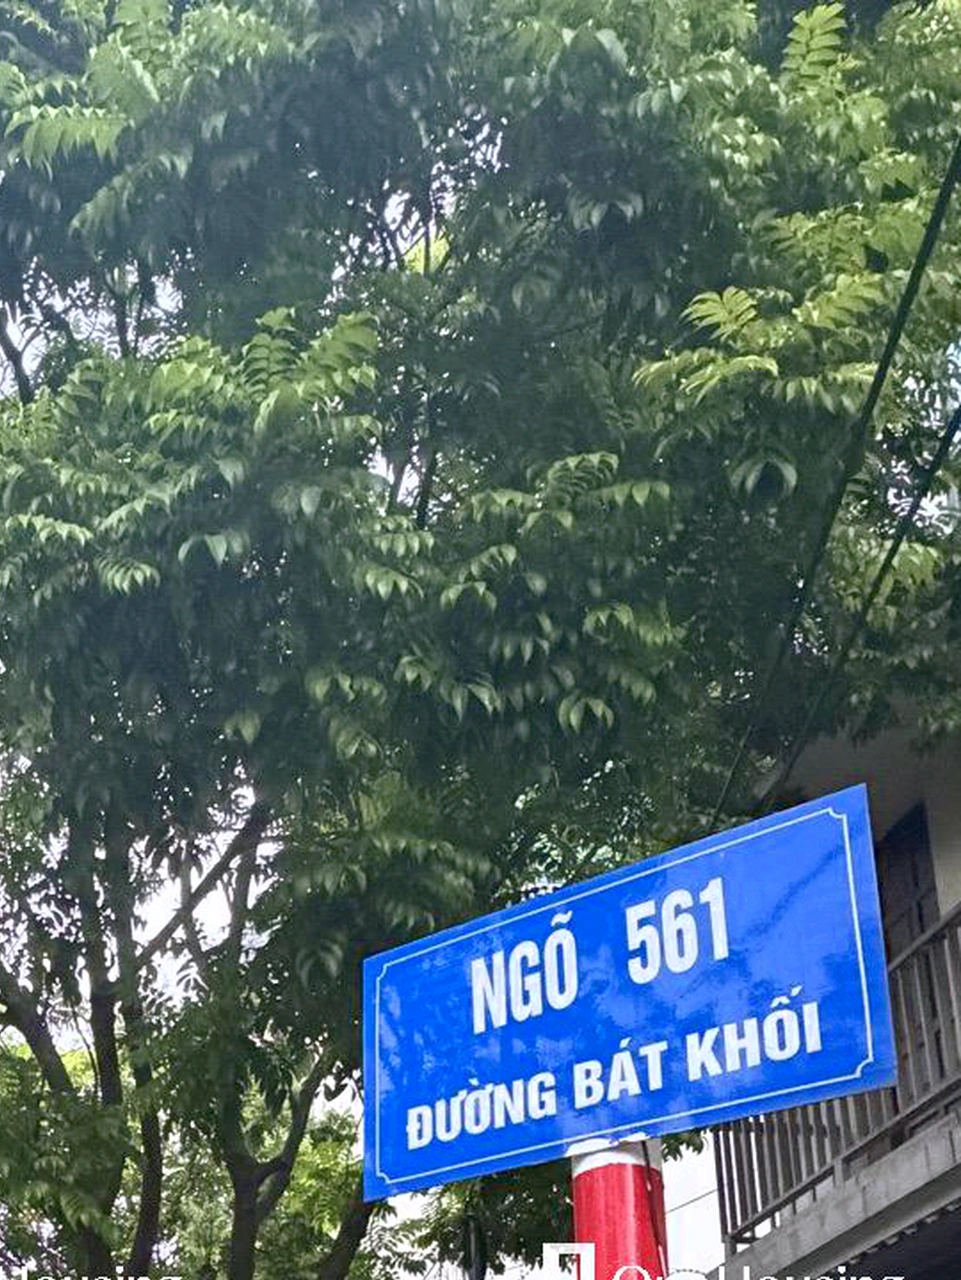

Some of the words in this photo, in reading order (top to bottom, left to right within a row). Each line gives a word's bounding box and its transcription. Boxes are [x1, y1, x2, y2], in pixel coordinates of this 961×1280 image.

[471, 911, 578, 1034] NGÕ
[626, 877, 730, 984] 561
[406, 1072, 557, 1150] ĐƯỜNG
[573, 1036, 668, 1110] BÁT
[685, 985, 822, 1081] KHỐI
